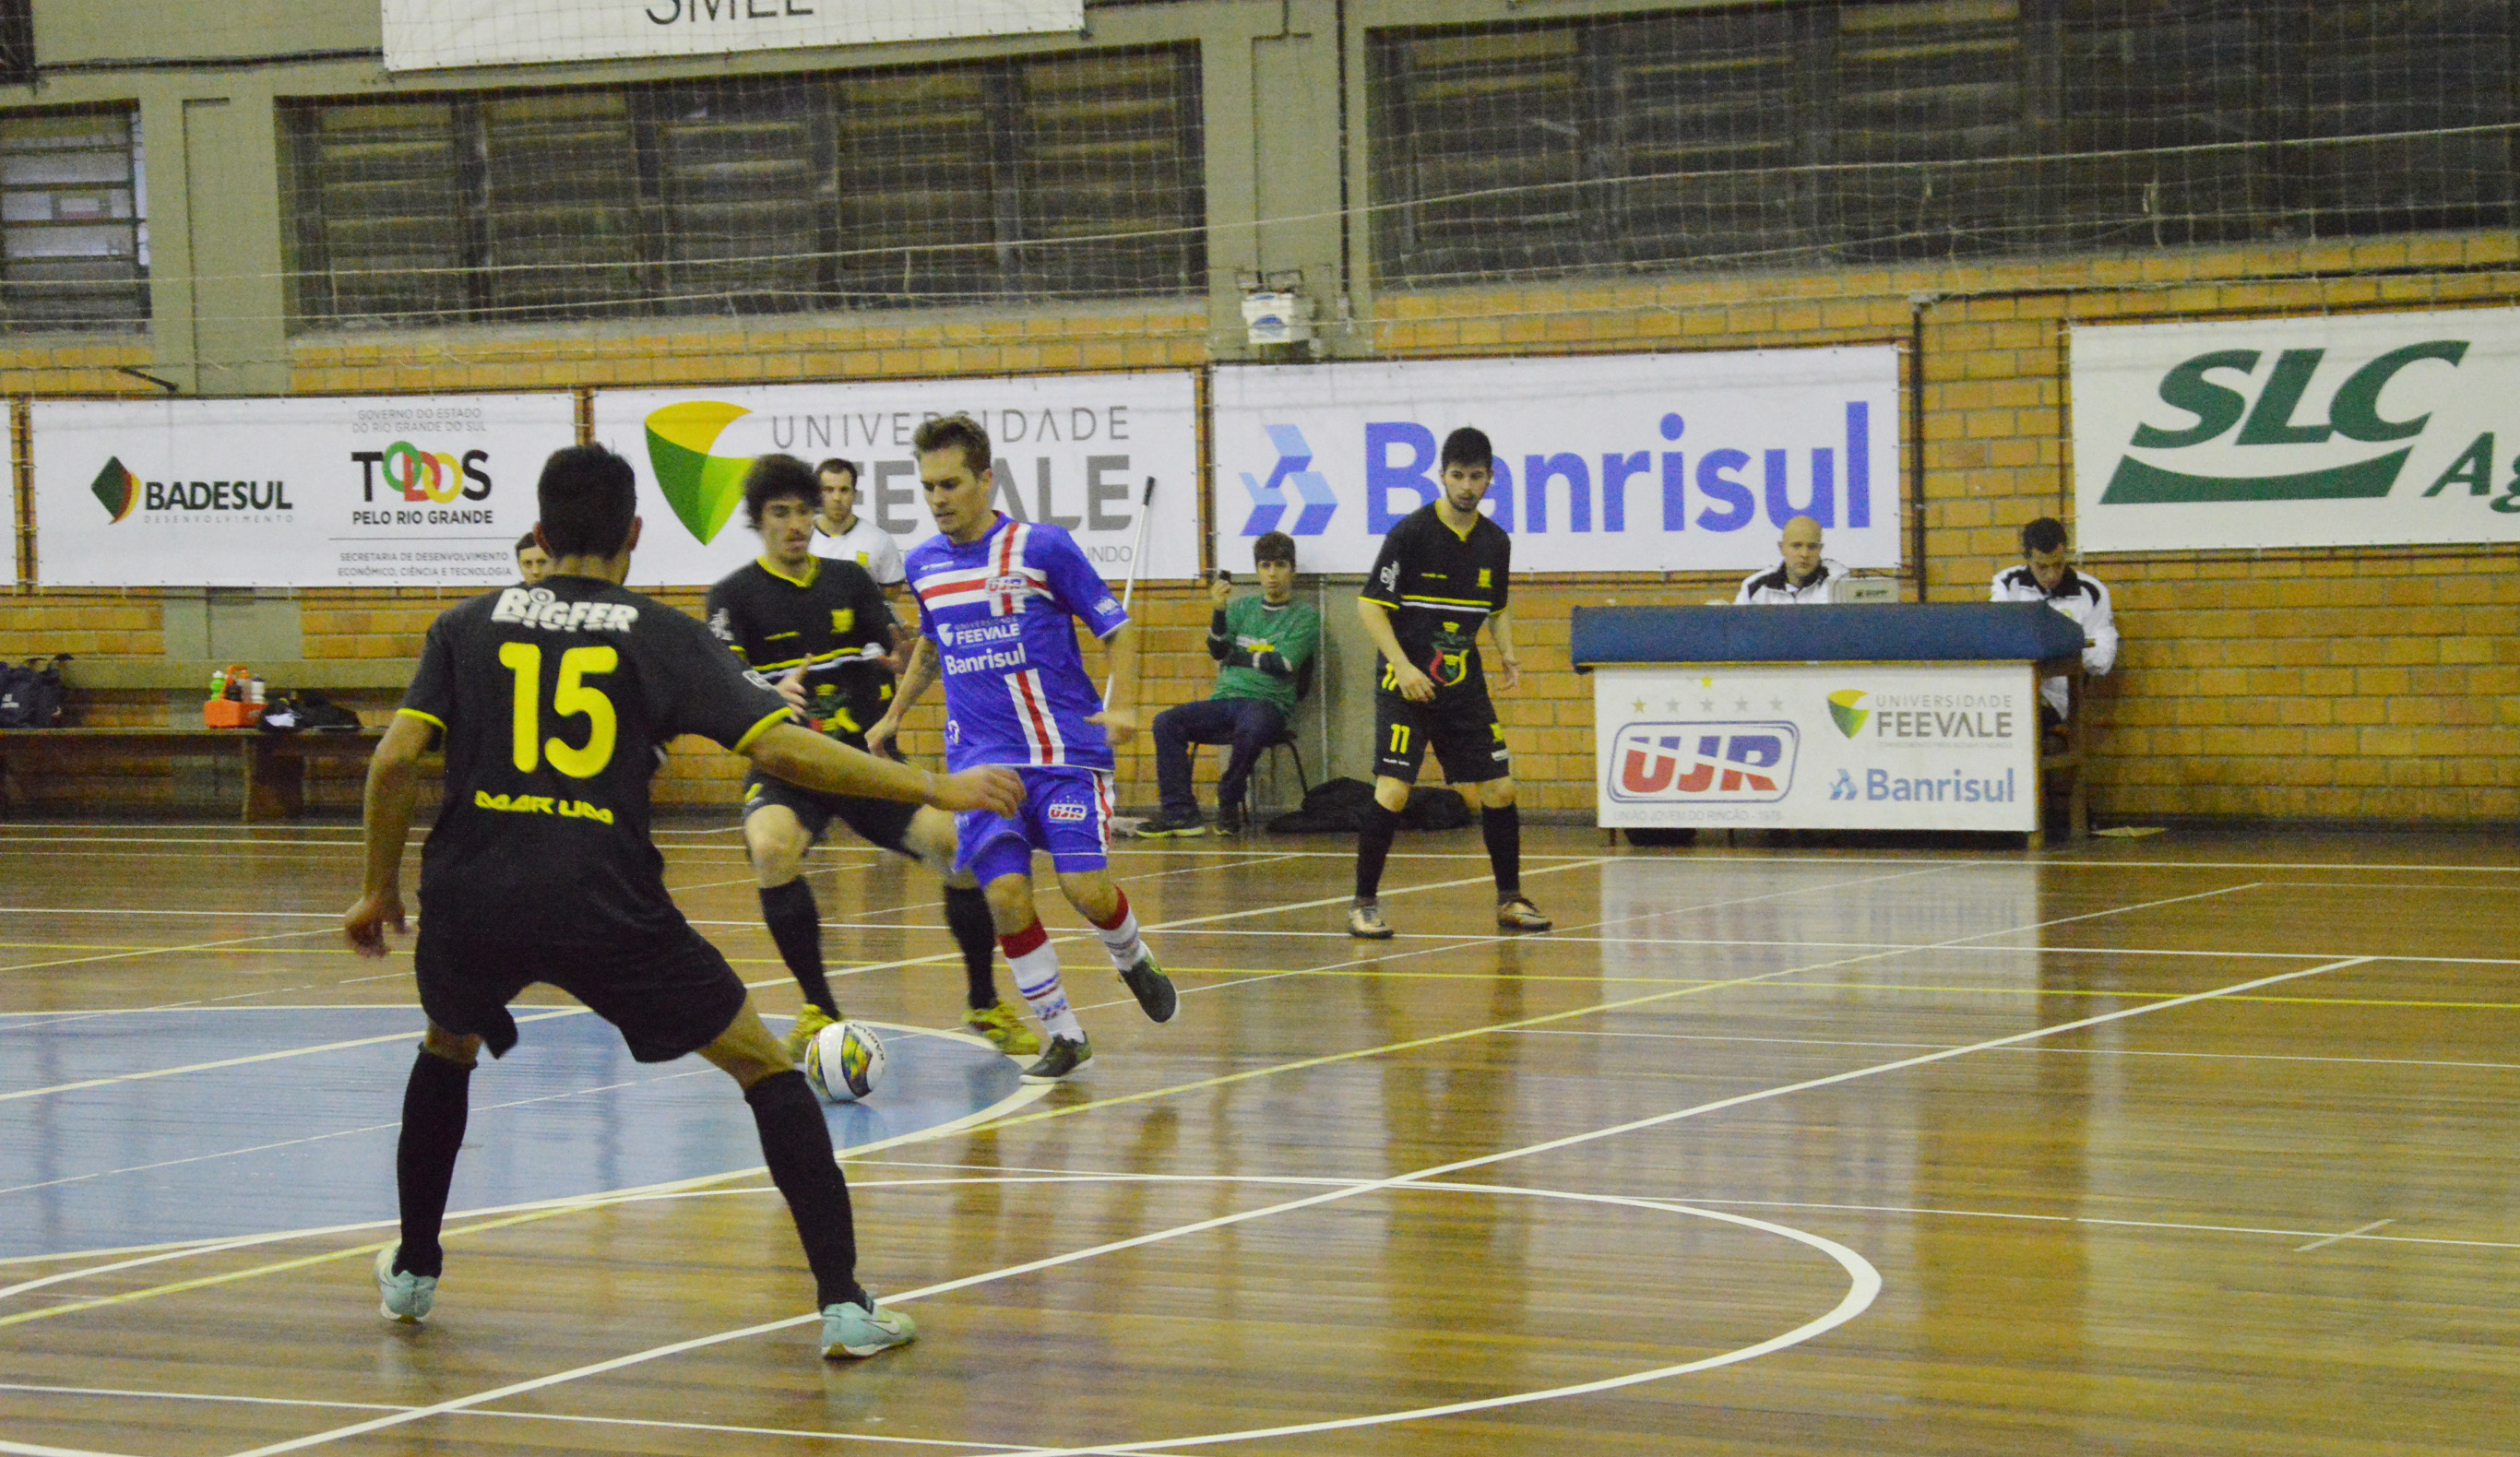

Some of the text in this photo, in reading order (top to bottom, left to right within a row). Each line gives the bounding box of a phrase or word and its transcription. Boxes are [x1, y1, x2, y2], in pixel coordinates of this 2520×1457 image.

[2129, 340, 2470, 449] SLC
[352, 421, 486, 432] DO RIO GRANDE DO SUL
[358, 408, 481, 420] GOVERNO DO ESTADO
[772, 406, 1129, 448] UNIVEIDADE
[351, 441, 492, 503] TODOS
[145, 480, 293, 510] BADESUL
[144, 515, 293, 524] DESENVOLVIMENTO
[352, 510, 493, 525] PELO RIO GRANDE
[340, 552, 508, 562] SECRETARIA DE DESENVOLVIMENTO
[400, 565, 438, 576] CIÊNCIA
[442, 567, 447, 576] E
[450, 567, 512, 576] TECNOLOGIA
[956, 622, 1021, 645] FEEVALE
[944, 642, 1026, 675] Banrisul
[498, 641, 618, 778] 15
[1876, 694, 2012, 707] UNIVERSIDADE
[1390, 723, 1410, 754] 11
[1877, 711, 2013, 738] FEEVALE
[1623, 735, 1782, 793] UJR
[1867, 767, 2015, 802] Banrisul
